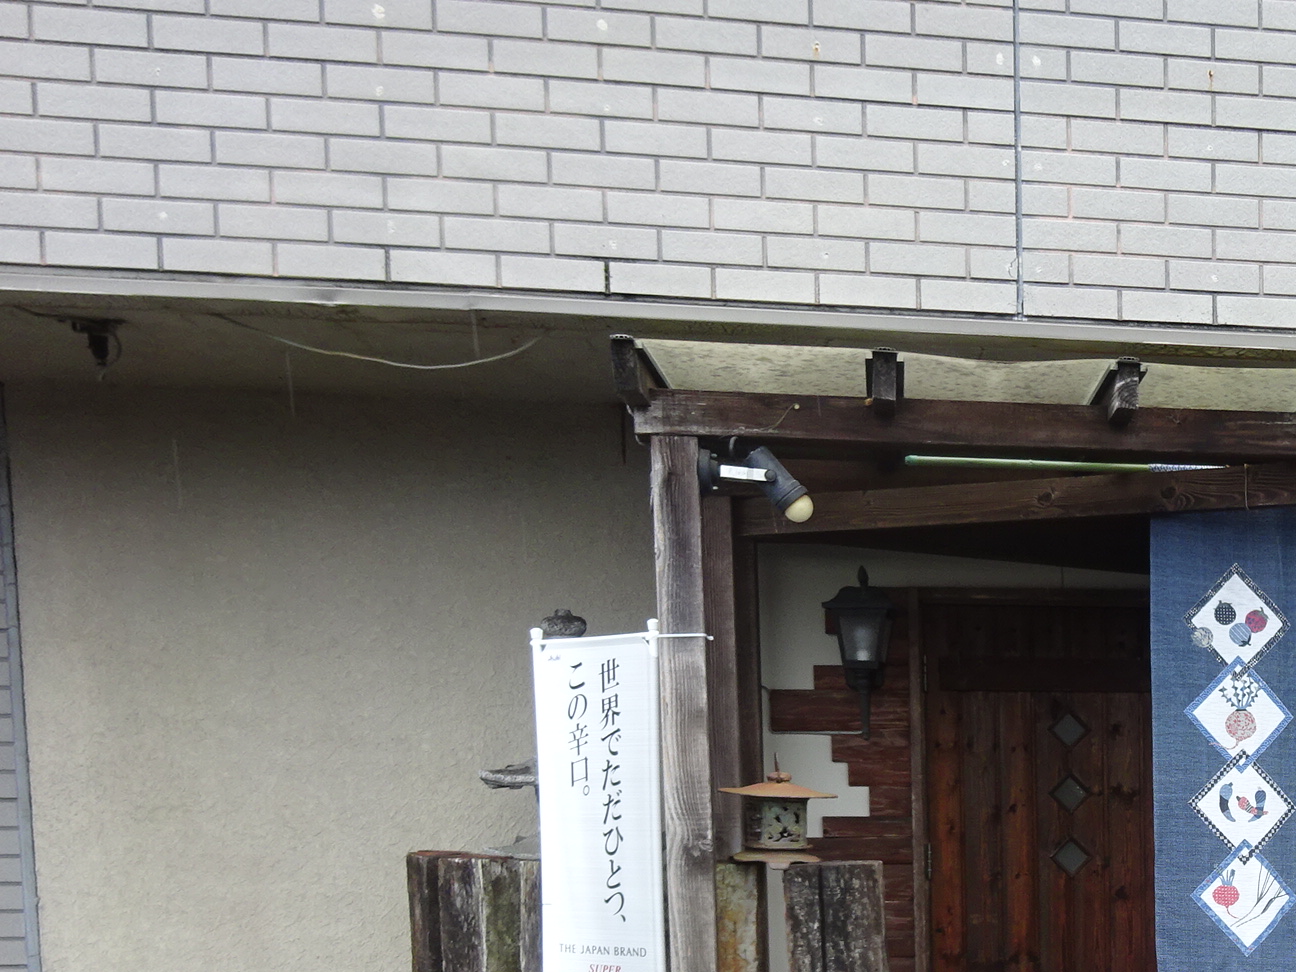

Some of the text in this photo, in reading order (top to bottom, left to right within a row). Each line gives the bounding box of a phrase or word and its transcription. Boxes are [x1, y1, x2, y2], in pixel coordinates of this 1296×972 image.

[568, 661, 590, 797] この辛口。
[599, 658, 626, 922] 世界でただひとつ、
[560, 943, 647, 958] THE JAPAN BRAND
